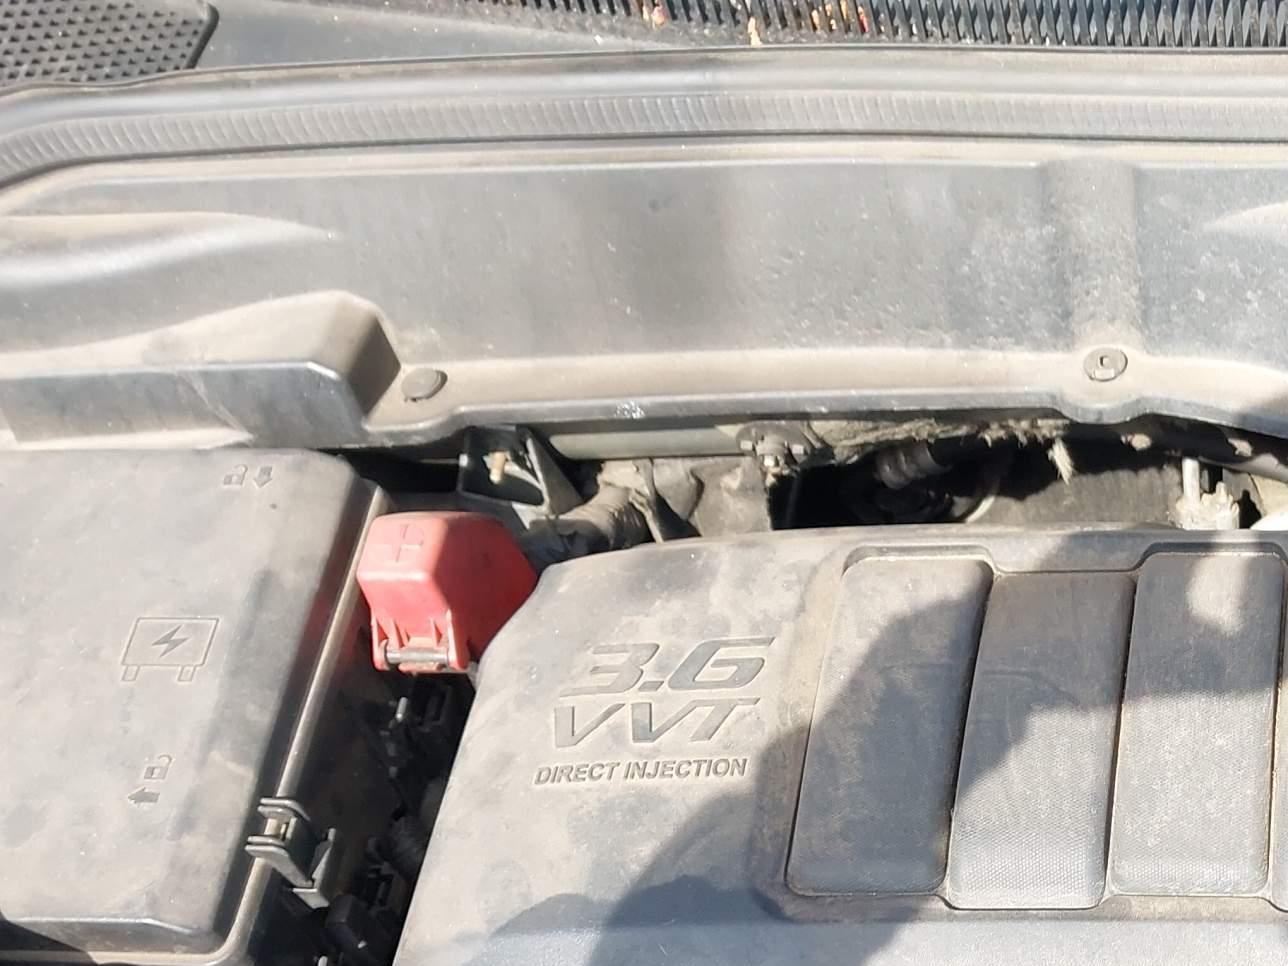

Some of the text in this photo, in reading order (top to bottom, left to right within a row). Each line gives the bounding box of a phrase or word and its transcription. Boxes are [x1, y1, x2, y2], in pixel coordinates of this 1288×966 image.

[558, 636, 776, 697] 3.6
[553, 697, 760, 747] VVT
[534, 757, 748, 785] DIRECT INJECTION
